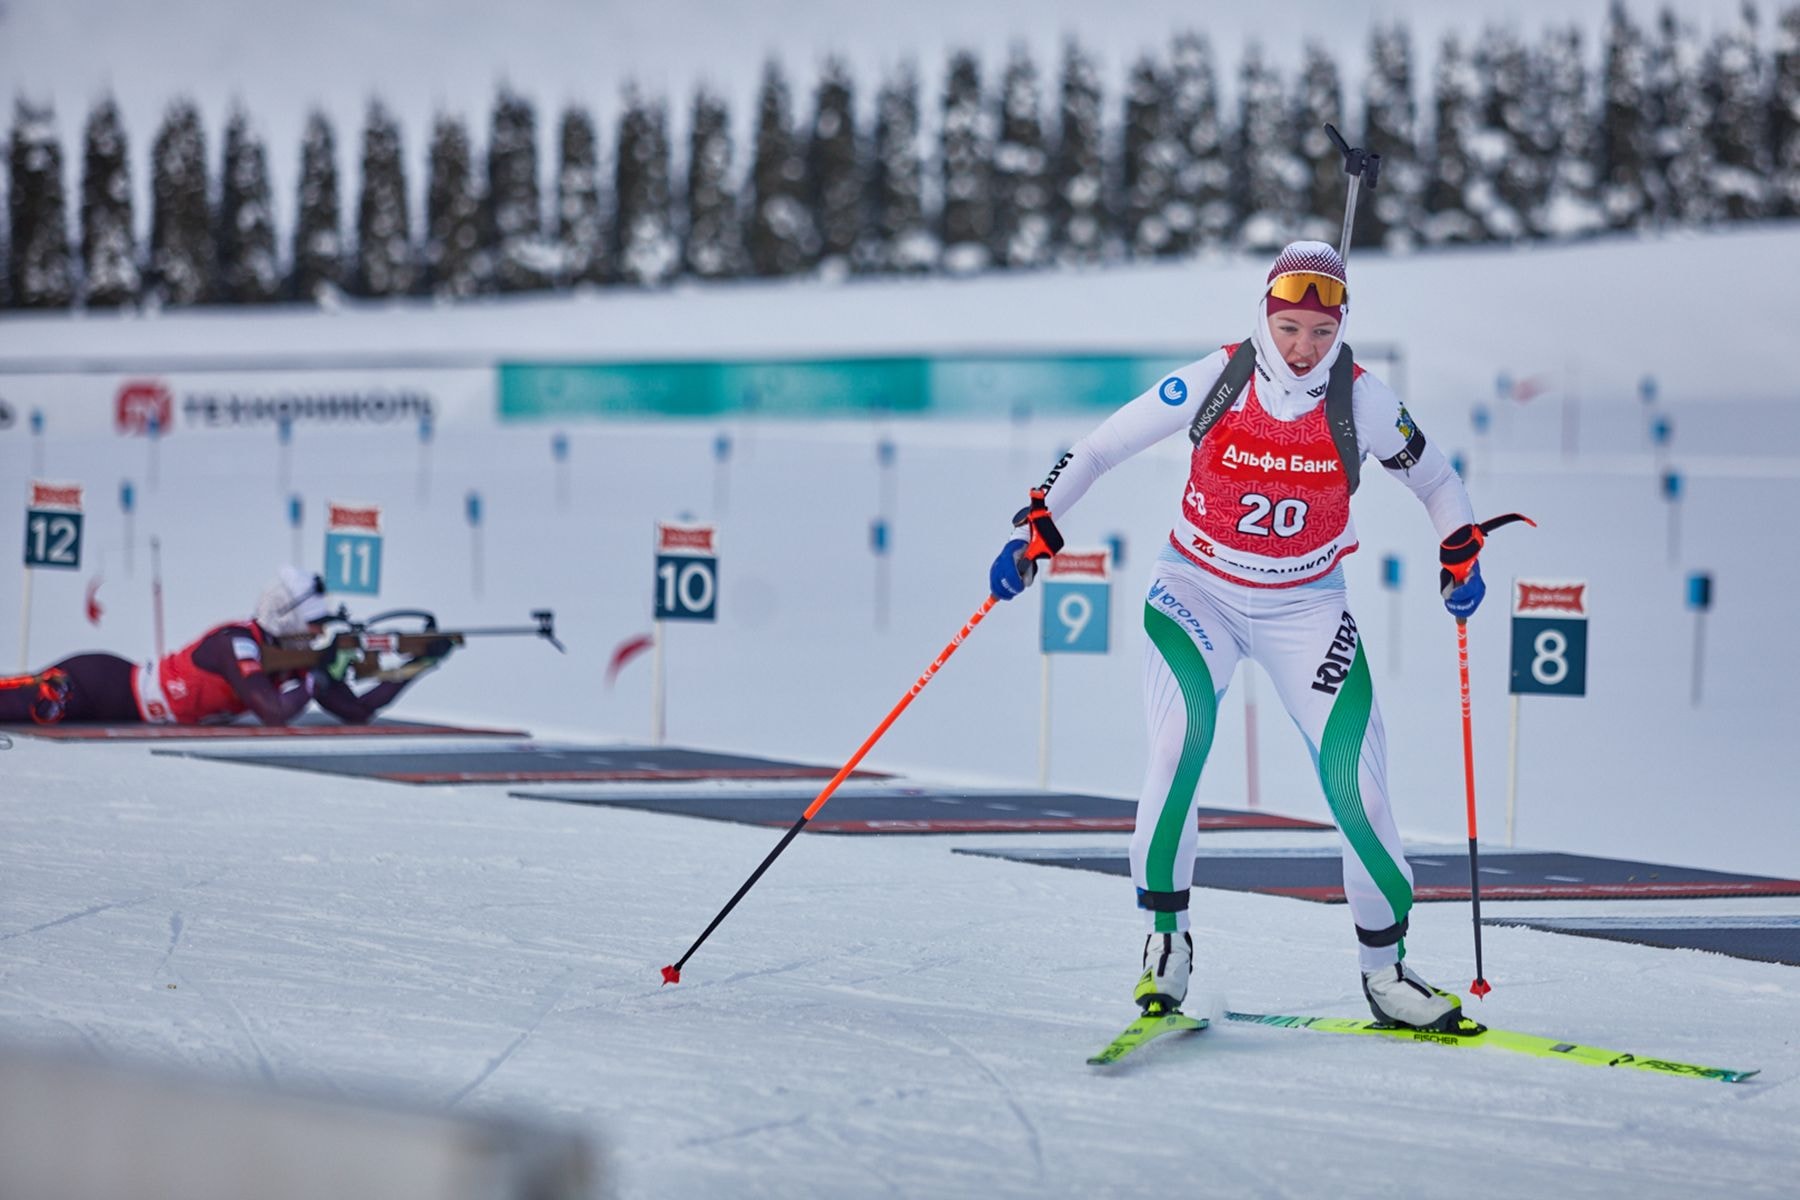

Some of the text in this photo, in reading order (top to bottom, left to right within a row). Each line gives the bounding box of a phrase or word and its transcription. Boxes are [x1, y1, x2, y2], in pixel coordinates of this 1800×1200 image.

[1222, 444, 1338, 473] Альфа Банк
[31, 516, 78, 562] 12
[1237, 493, 1309, 538] 20
[336, 541, 370, 587] 11
[659, 561, 714, 613] 10
[1057, 592, 1093, 644] 9
[1160, 593, 1214, 651] ЮГОРИЯ
[1311, 610, 1358, 696] ЮГРА
[1531, 628, 1569, 686] 8
[1413, 1032, 1459, 1046] FISCHER
